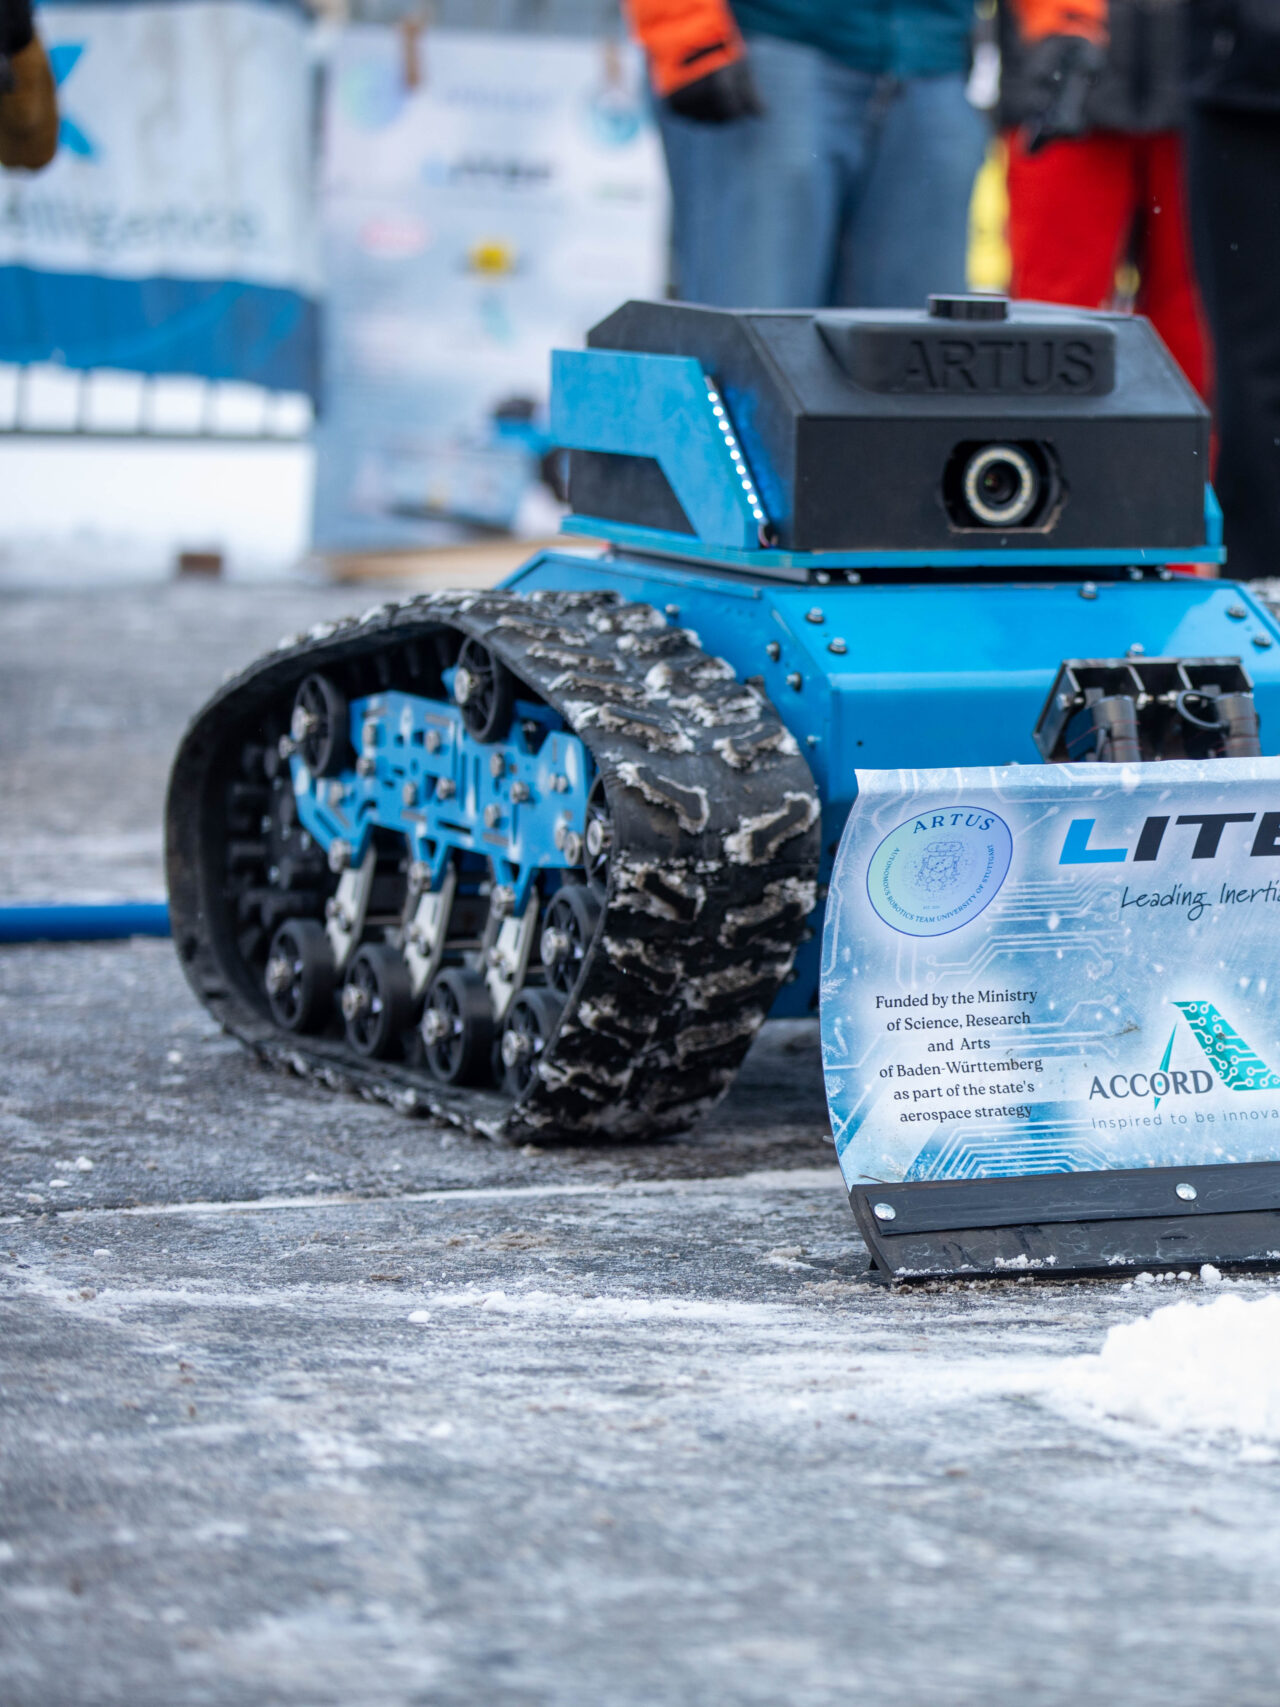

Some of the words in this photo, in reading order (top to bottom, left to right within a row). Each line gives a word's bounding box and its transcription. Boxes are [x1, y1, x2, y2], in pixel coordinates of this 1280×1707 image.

[889, 339, 1097, 392] ARTUS
[913, 813, 995, 834] ARTUS
[915, 914, 936, 923] TEAM
[936, 893, 976, 921] UNIVERSITY
[1121, 883, 1212, 921] Leading
[875, 993, 929, 1009] Funded
[932, 992, 949, 1009] by
[951, 991, 975, 1005] the
[977, 989, 1038, 1004] Ministry
[887, 1017, 902, 1031] of
[904, 1016, 963, 1031] Science,
[966, 1011, 1031, 1027] Research
[927, 1038, 954, 1052] and
[960, 1037, 991, 1051] Arts
[879, 1064, 894, 1078] of
[896, 1058, 1044, 1078] Baden-Württemberg
[893, 1089, 910, 1100] as
[913, 1086, 943, 1102] part
[946, 1083, 961, 1097] of
[963, 1083, 986, 1096] the
[989, 1080, 1035, 1094] state's
[1089, 1069, 1214, 1100] ACCORD
[899, 1108, 972, 1123] aerospace
[974, 1103, 1033, 1119] strategy
[1091, 1113, 1163, 1130] Inspired
[1170, 1113, 1188, 1125] to
[1194, 1111, 1216, 1123] be
